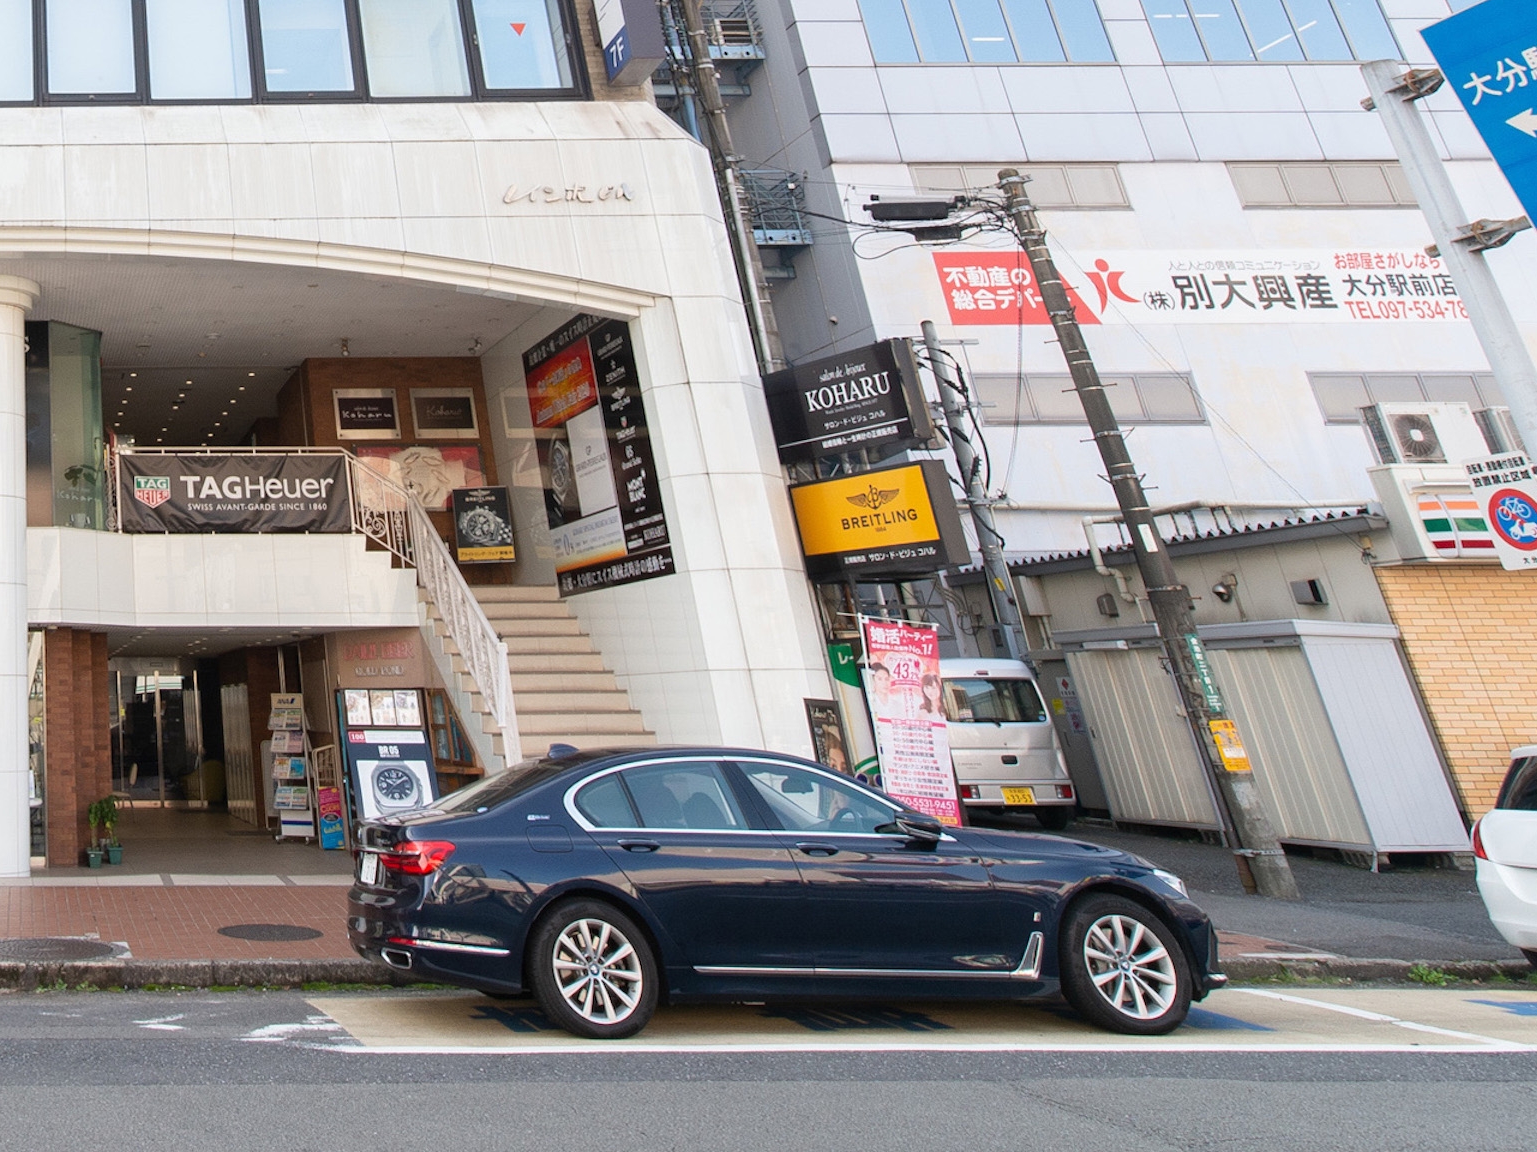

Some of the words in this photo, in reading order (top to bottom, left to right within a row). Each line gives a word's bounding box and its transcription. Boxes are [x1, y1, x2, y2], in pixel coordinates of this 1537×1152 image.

[610, 36, 624, 68] 7F
[942, 266, 1031, 287] 不動産の
[1168, 260, 1320, 272] 人と人との信頼コミュニケーション
[1342, 274, 1458, 297] 大分駅前店
[951, 289, 1071, 311] 総合デパー
[805, 371, 891, 413] KOHARU
[137, 478, 168, 489] TAG
[136, 489, 170, 504] HEUER
[187, 502, 214, 511] SWISS
[216, 502, 276, 511] AVANT-GARDE
[279, 502, 305, 511] SINCE
[308, 502, 328, 511] 1860
[841, 508, 918, 530] BREITLING
[918, 546, 936, 557] コハル
